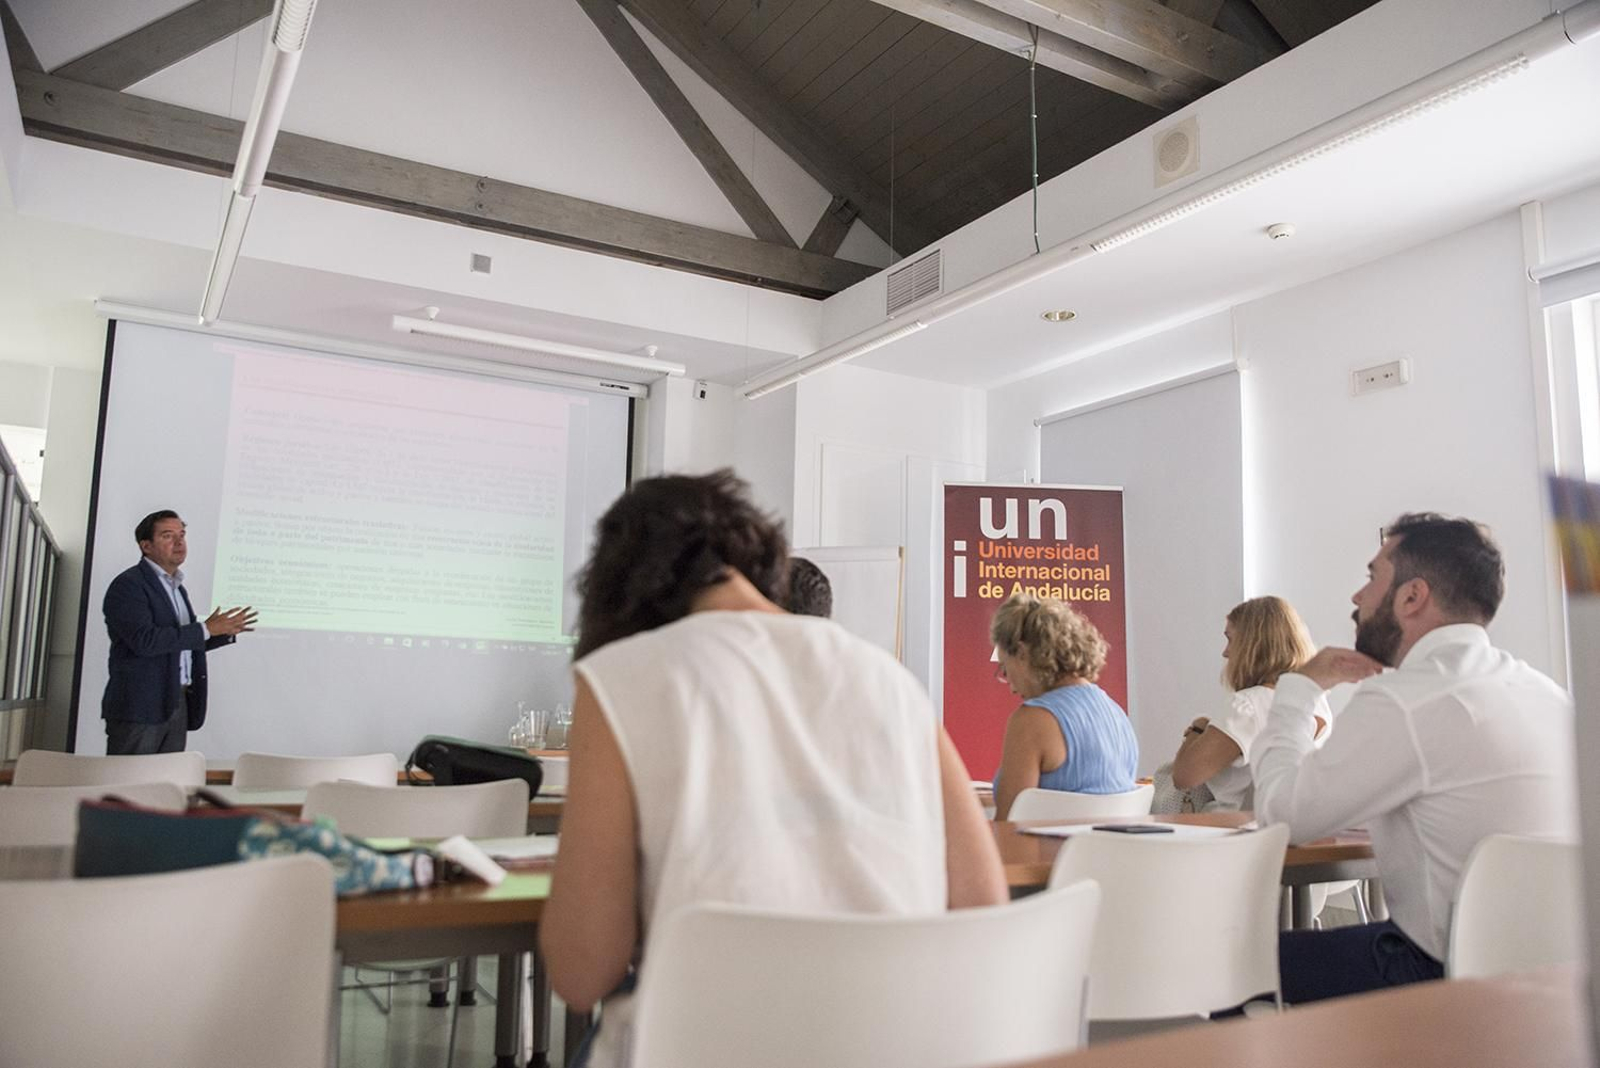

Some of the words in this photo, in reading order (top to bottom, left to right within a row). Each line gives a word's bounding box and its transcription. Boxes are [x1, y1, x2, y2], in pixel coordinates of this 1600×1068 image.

[979, 497, 1067, 540] un
[978, 541, 1099, 561] Universidad
[978, 561, 1111, 581] Internacional
[978, 581, 1004, 598] de
[1009, 582, 1111, 601] Andalucía
